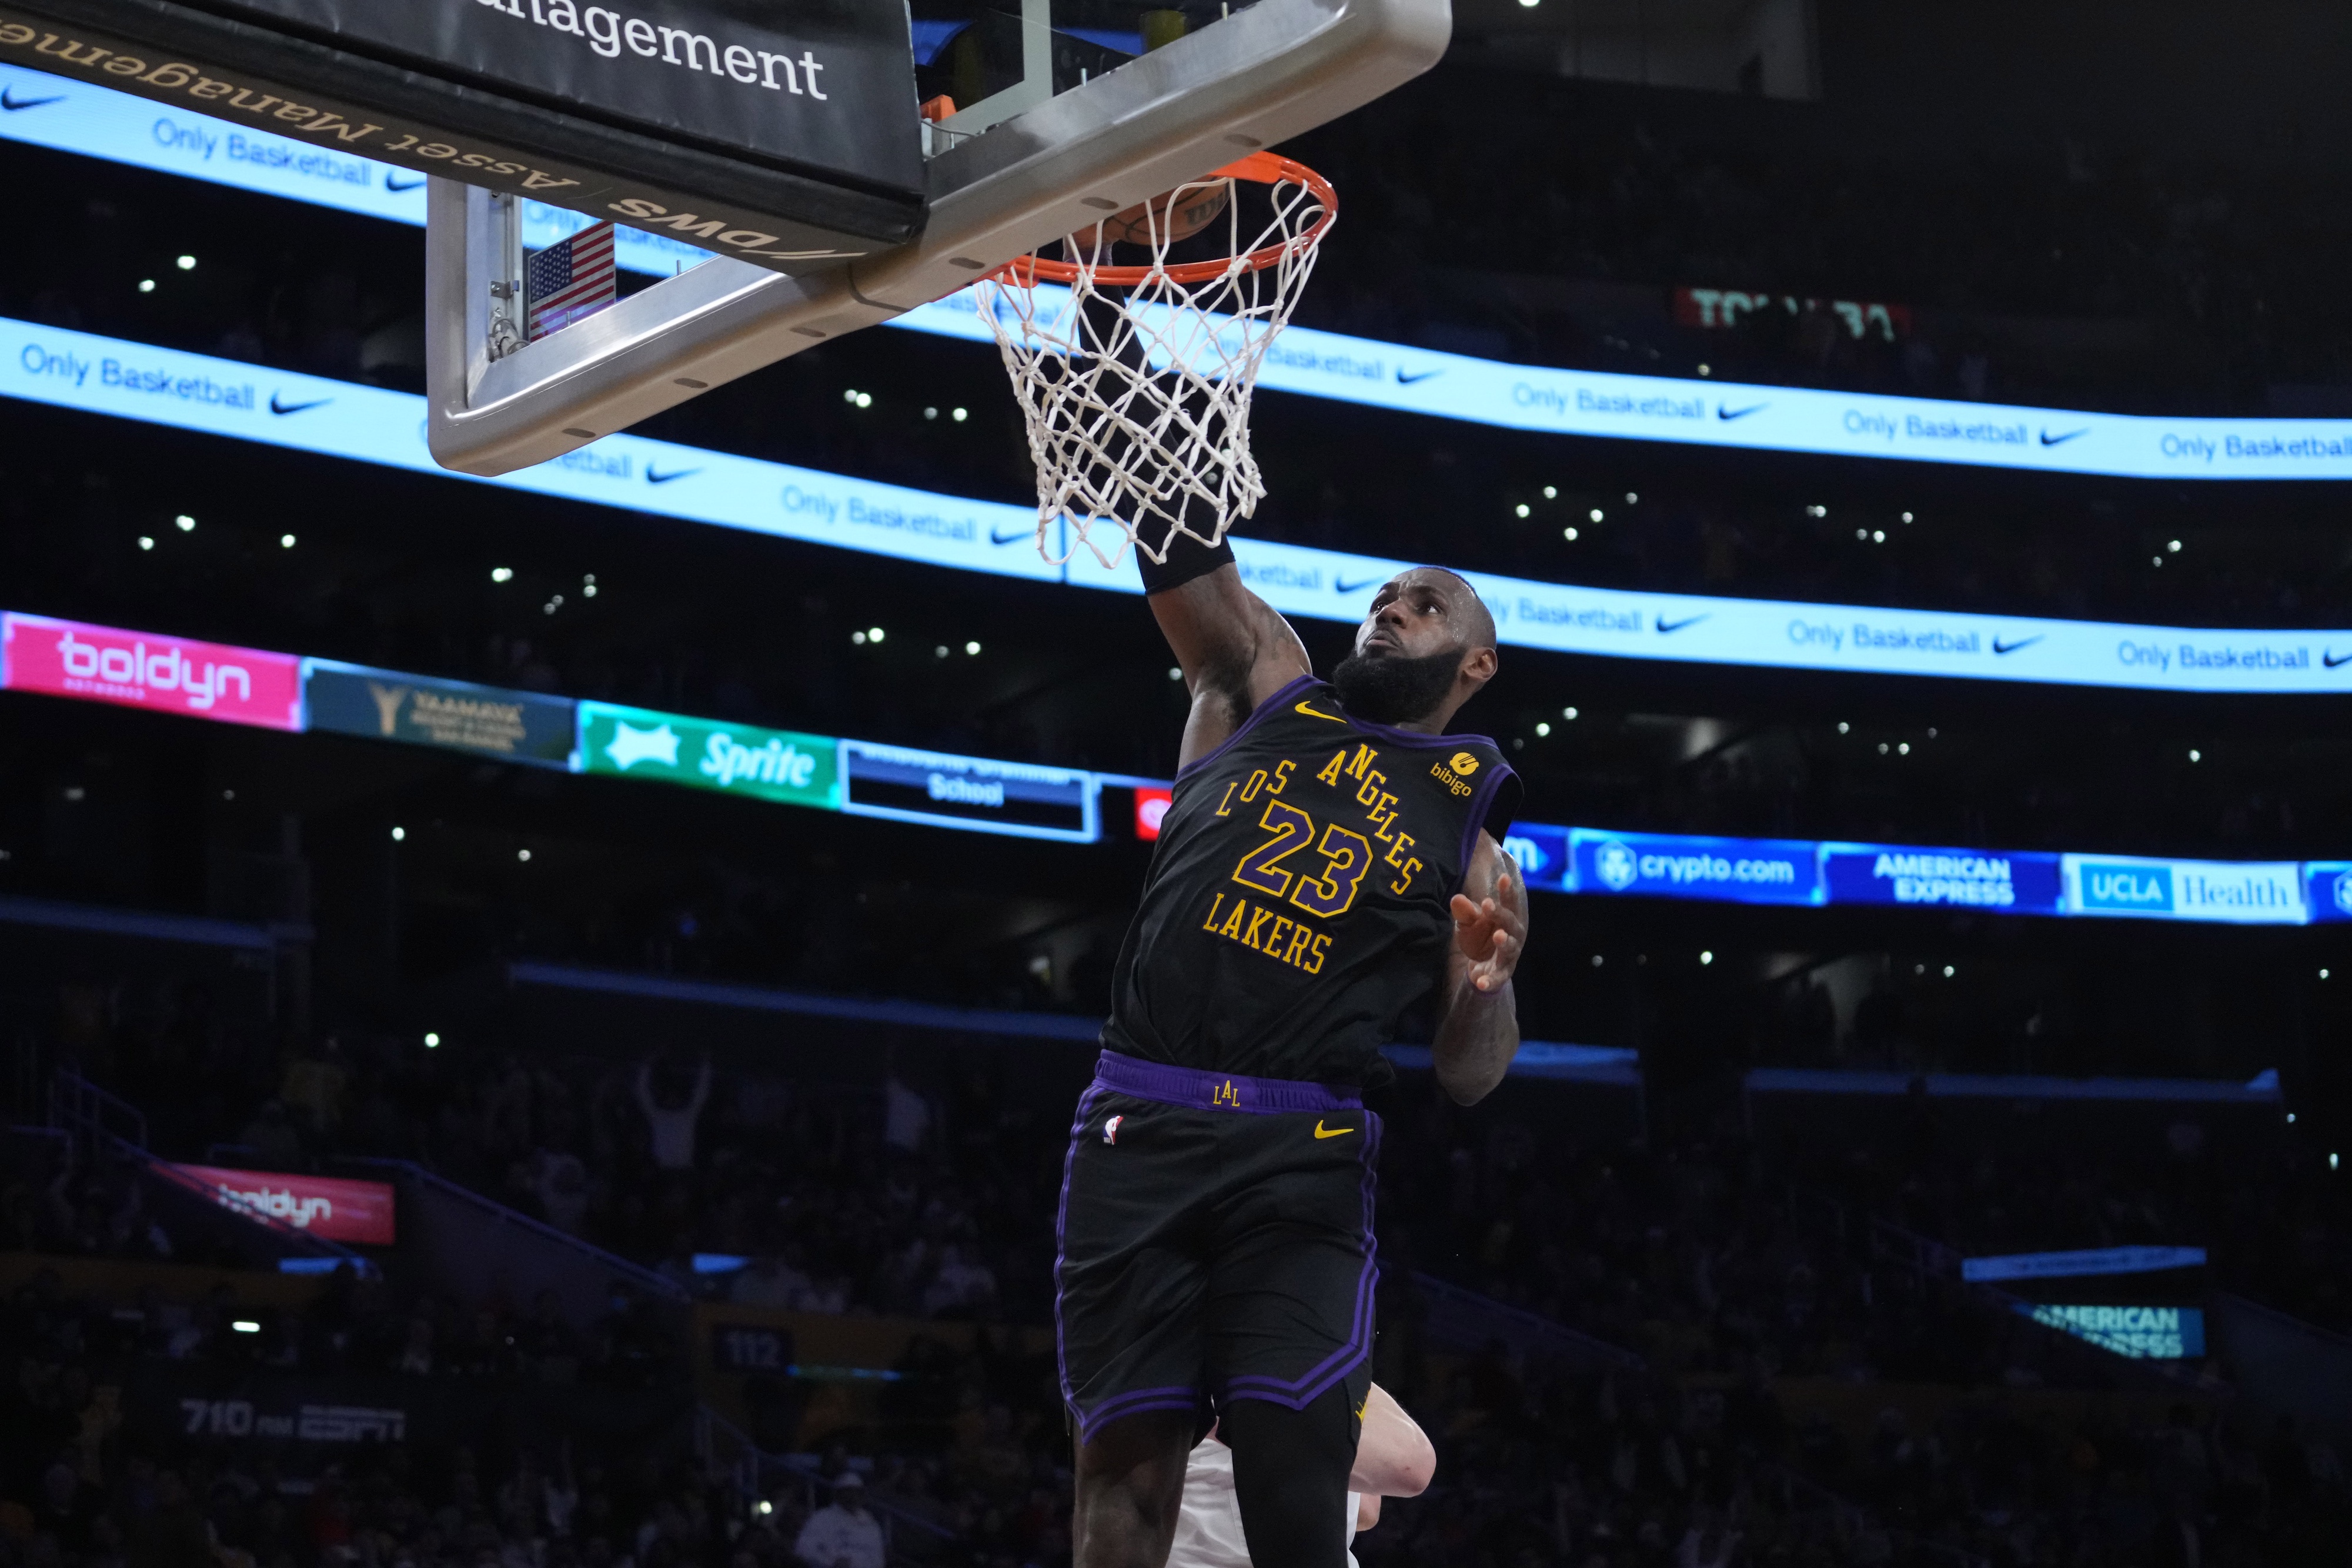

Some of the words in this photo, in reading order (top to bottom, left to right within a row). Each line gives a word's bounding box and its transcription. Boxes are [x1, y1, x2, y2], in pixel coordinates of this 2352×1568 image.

[0, 19, 385, 143] Manageme
[152, 118, 218, 161] Only
[228, 135, 372, 186] Basketball
[385, 134, 581, 190] Asset
[607, 198, 780, 248] DWS
[21, 343, 90, 386] Only
[102, 361, 253, 410] Basketball
[1512, 382, 1569, 416] Only
[1578, 389, 1705, 419] Basketball
[1843, 410, 1899, 443] Only
[1907, 415, 2027, 445] Basketball
[2161, 433, 2216, 463] Only
[782, 485, 841, 523] Only
[849, 497, 977, 541] Basketball
[1517, 597, 1642, 631] Basketball
[1788, 620, 1844, 653] Only
[1854, 623, 1980, 654] Basketball
[56, 631, 250, 710] boldyn
[2117, 639, 2171, 673] Only
[2179, 643, 2309, 669] Basketball
[699, 733, 816, 787] Sprite
[927, 773, 1004, 807] School
[1215, 760, 1297, 817] LOS
[1430, 762, 1472, 797] bibigo
[1316, 743, 1424, 895] ANGELES
[1231, 798, 1374, 918] 23
[1639, 854, 1795, 884] crypto.com
[1873, 854, 2012, 881] AMERICAN
[1894, 878, 2016, 905] EXPRESS
[2092, 875, 2164, 902] UCLA
[2184, 876, 2288, 908] Health
[1202, 892, 1333, 975] LAKERS
[1213, 1080, 1241, 1107] LAL
[180, 1398, 253, 1436] 710
[298, 1403, 406, 1441] ESPN
